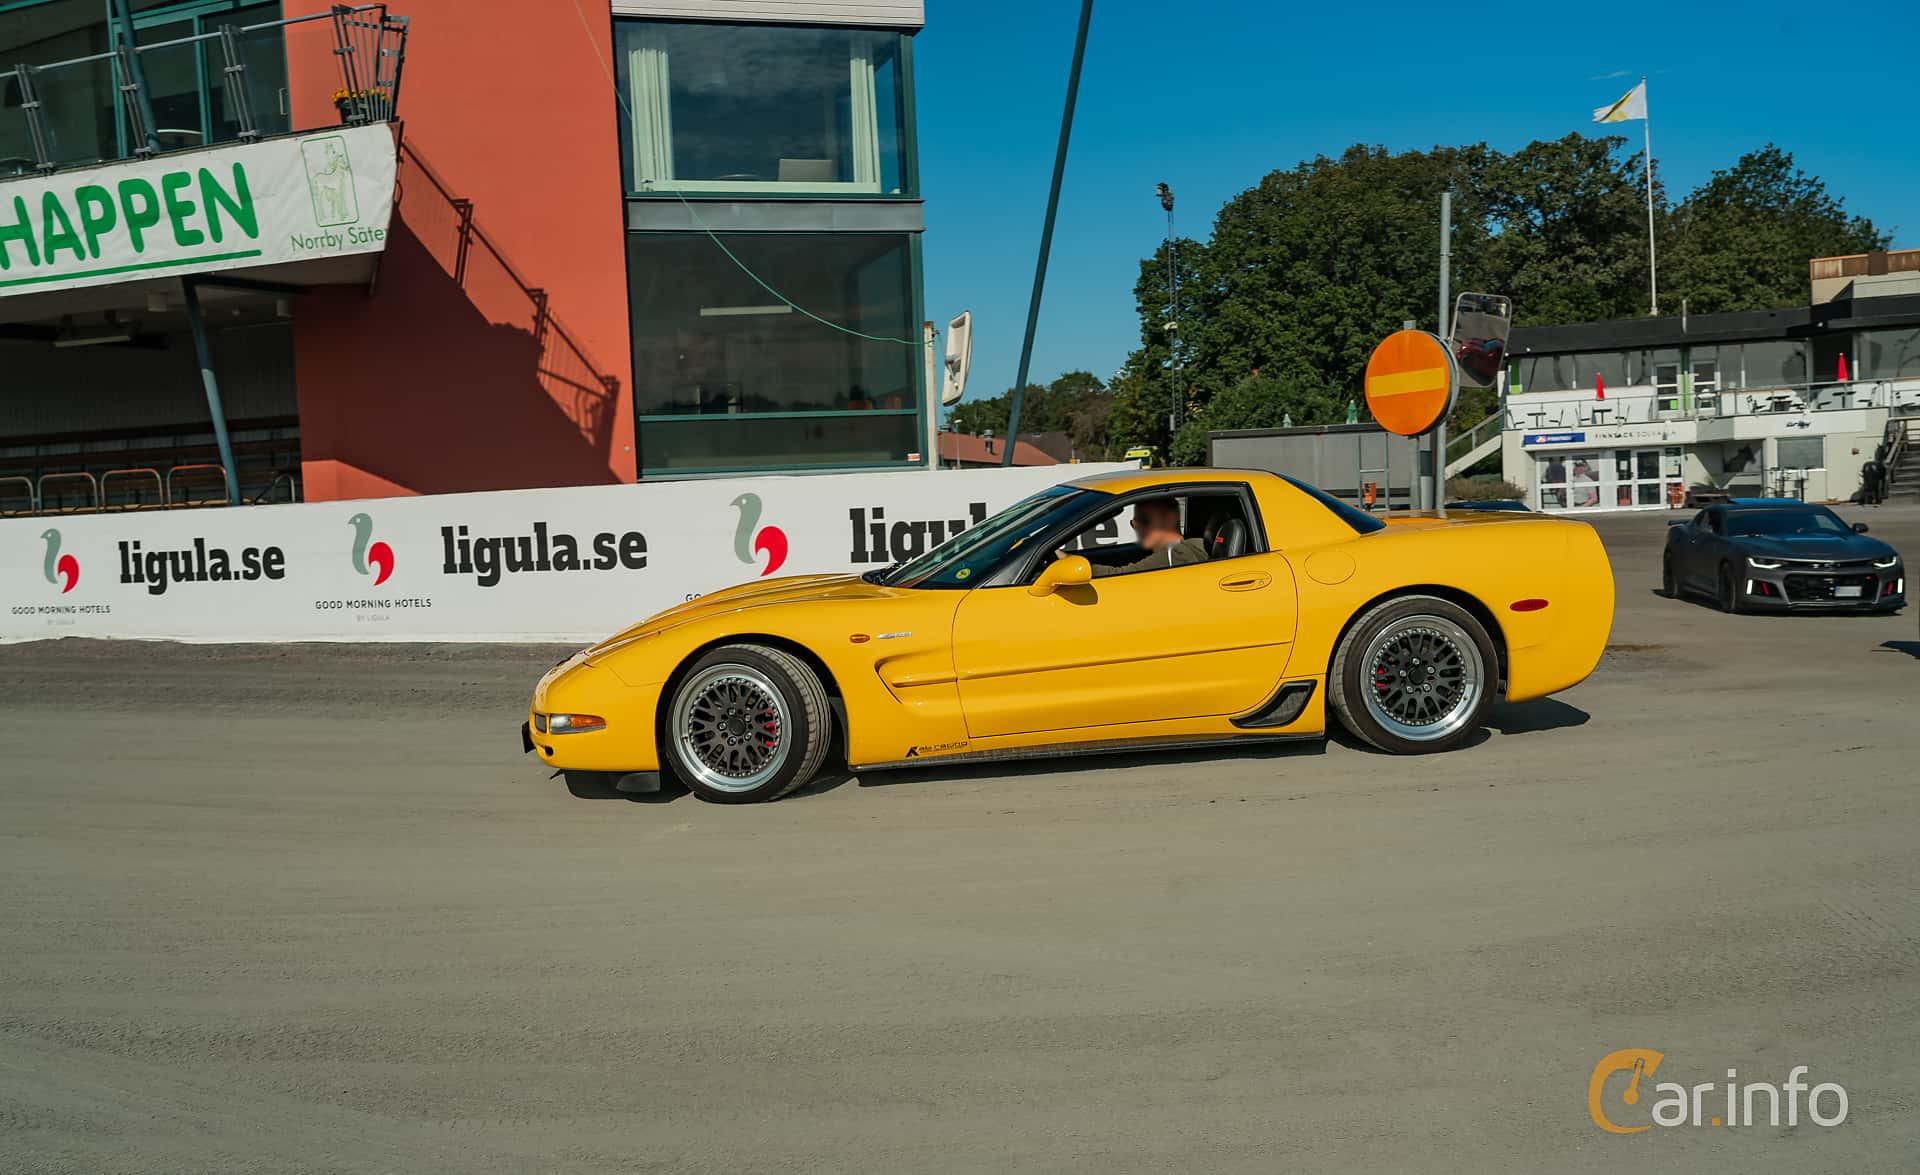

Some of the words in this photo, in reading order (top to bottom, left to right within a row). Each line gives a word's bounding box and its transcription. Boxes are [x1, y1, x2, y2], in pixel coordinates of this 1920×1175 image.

[290, 229, 343, 253] Norrby
[118, 537, 286, 595] ligula.se
[441, 521, 648, 588] ligula.se
[11, 605, 36, 615] GOOD
[38, 604, 77, 614] MORNING
[79, 603, 111, 614] HOTELS
[315, 600, 343, 609] GOOD
[346, 599, 391, 609] MORNING
[394, 598, 432, 608] HOTELS
